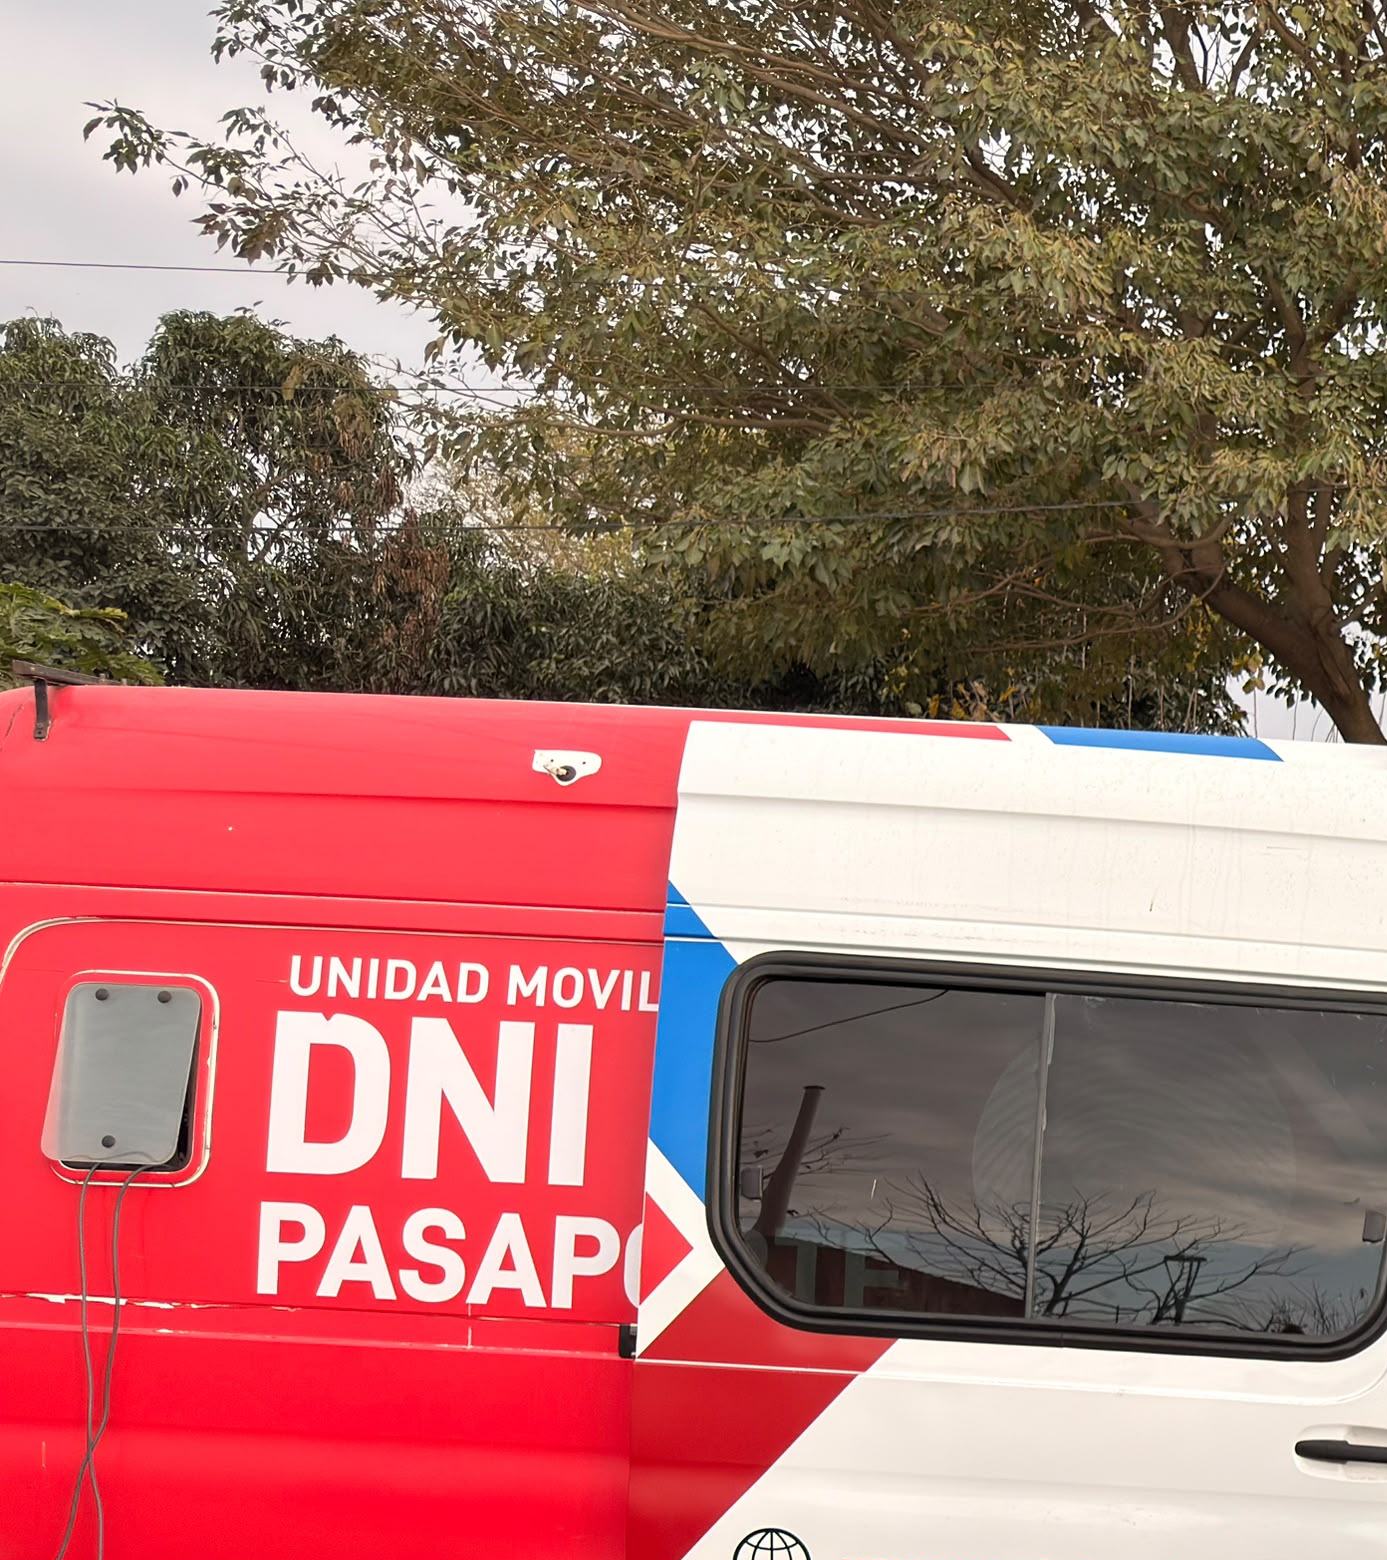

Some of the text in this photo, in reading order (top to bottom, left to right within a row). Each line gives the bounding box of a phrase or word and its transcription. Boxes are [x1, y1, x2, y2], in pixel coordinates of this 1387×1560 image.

[290, 955, 660, 1013] UNIDAD MOVIL
[266, 1011, 594, 1187] DNI
[257, 1202, 643, 1308] PASAP
